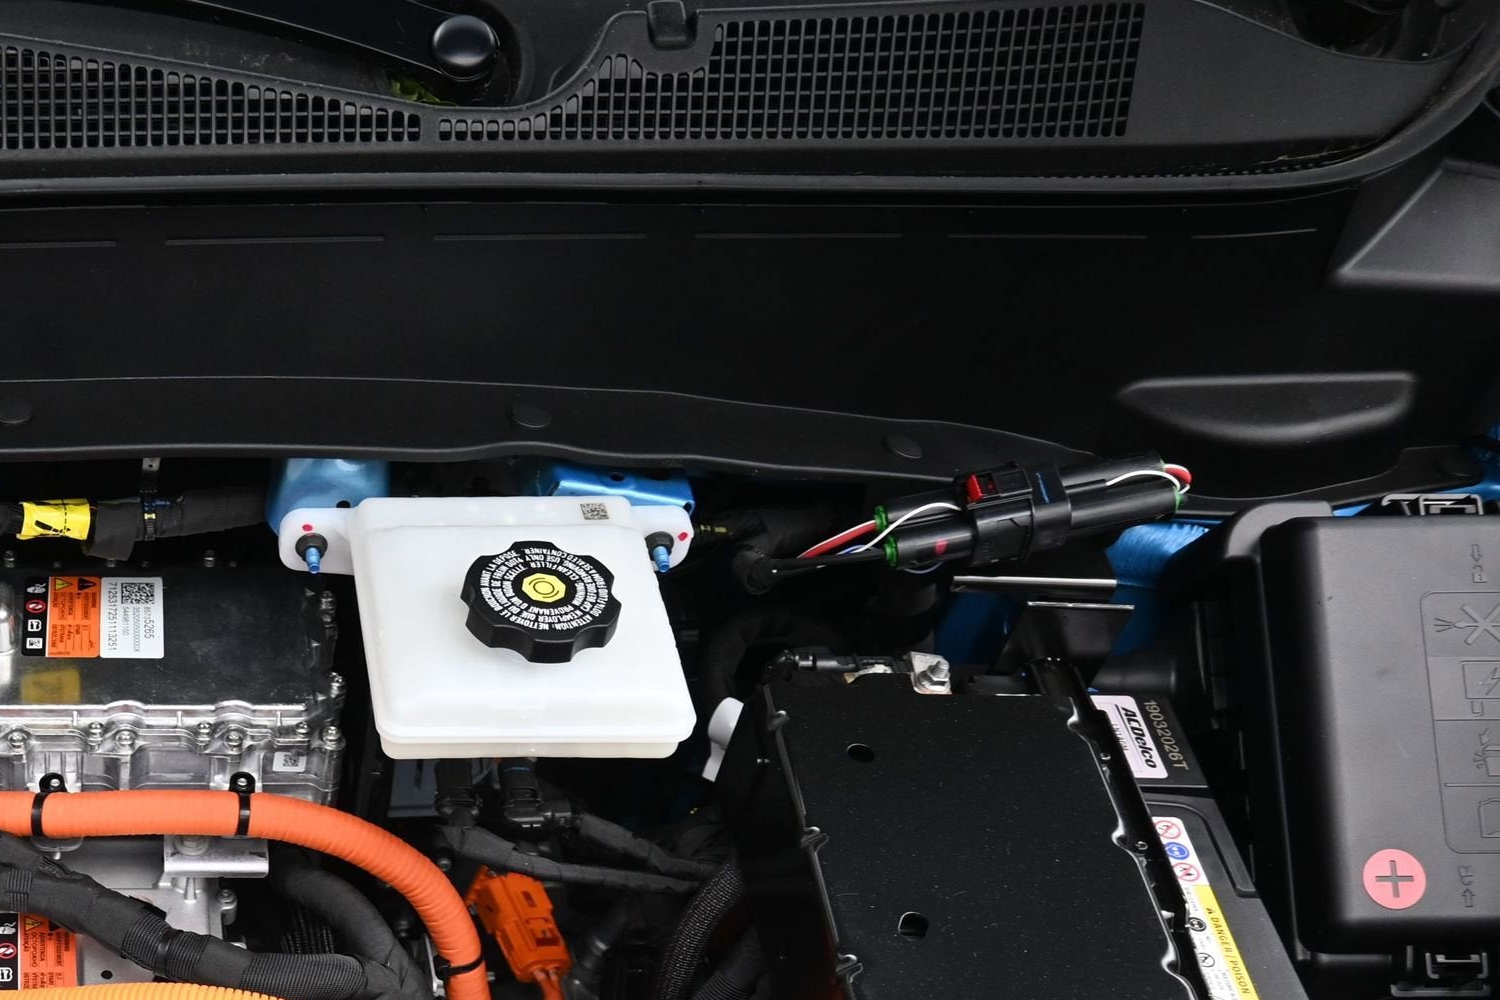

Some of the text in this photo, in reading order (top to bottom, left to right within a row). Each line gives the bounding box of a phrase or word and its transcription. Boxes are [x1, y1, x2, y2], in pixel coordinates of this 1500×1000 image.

[524, 554, 545, 562] ONLY
[529, 560, 558, 570] FILLER
[545, 554, 561, 564] USE
[566, 554, 594, 571] SEALED
[591, 573, 607, 589] FROM
[509, 614, 550, 631] NETTOYER
[1121, 706, 1157, 768] ACDelco
[1143, 700, 1189, 770] 19032026T
[1211, 917, 1233, 954] DANGER
[1228, 960, 1251, 995] POISON
